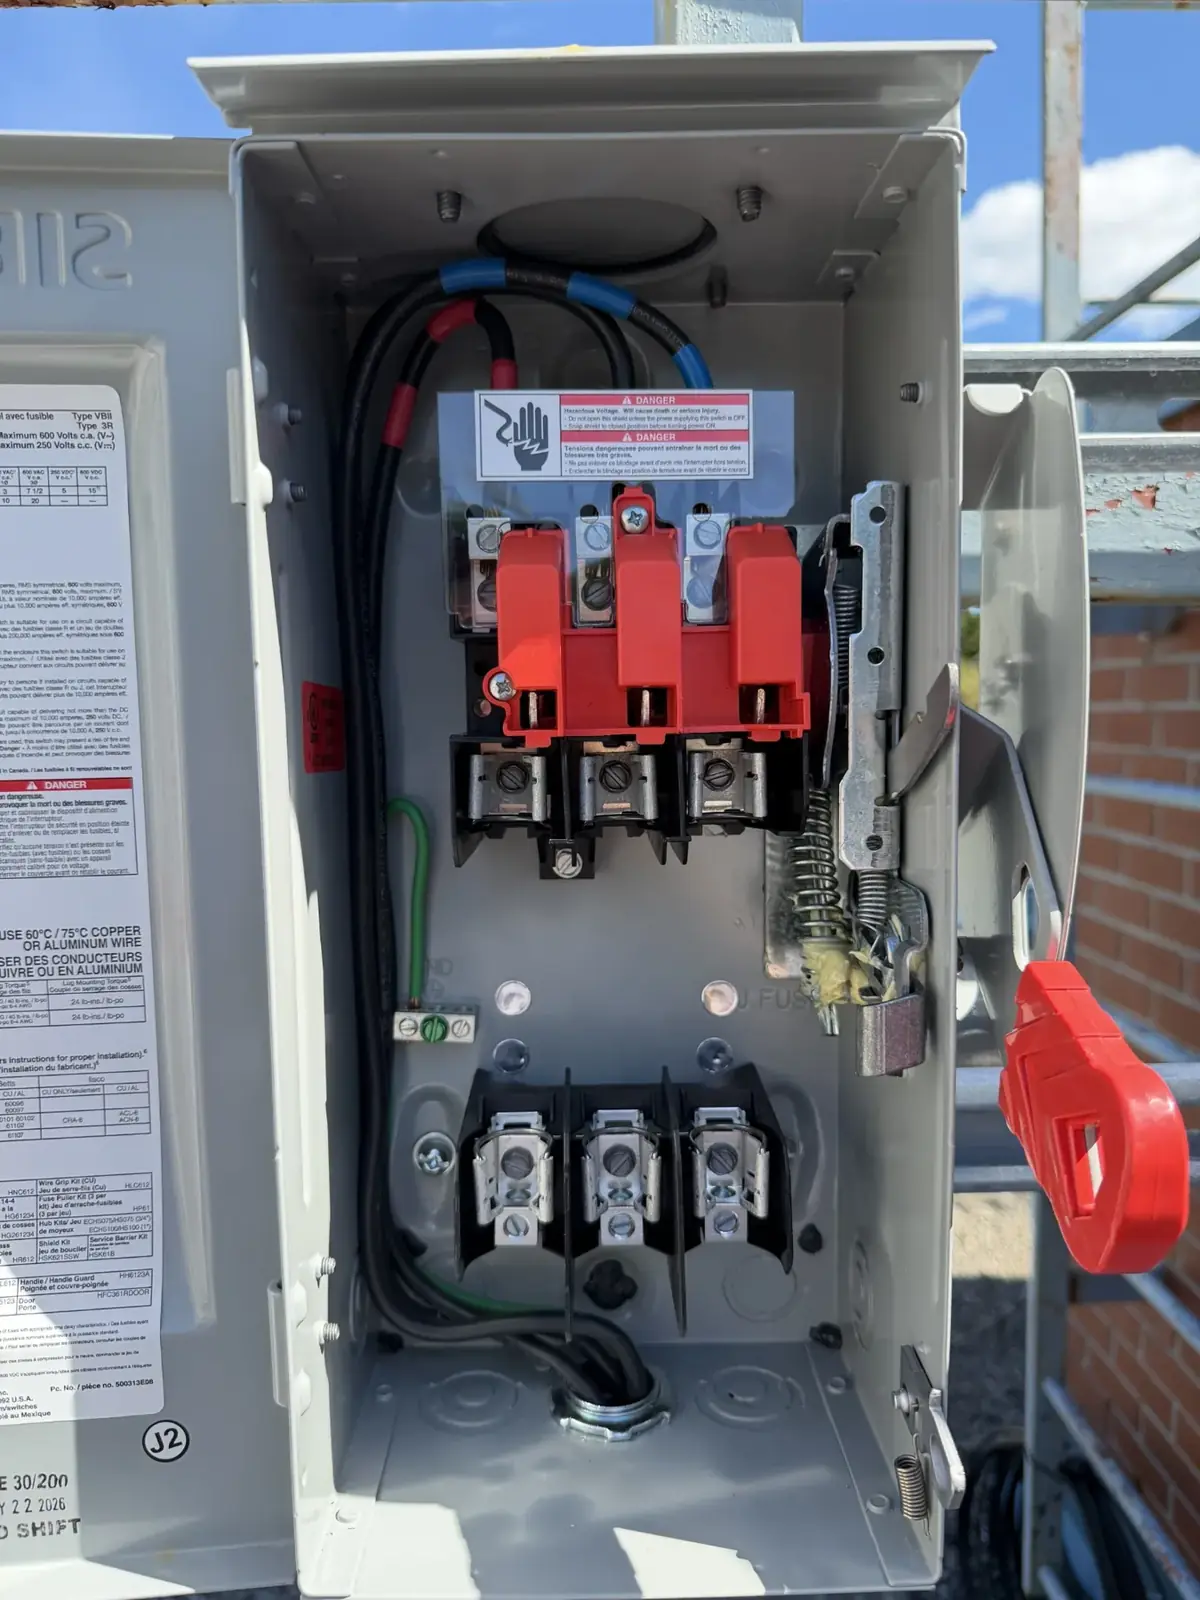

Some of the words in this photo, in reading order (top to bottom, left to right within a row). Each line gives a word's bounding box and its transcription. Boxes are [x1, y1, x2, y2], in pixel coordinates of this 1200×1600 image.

[635, 396, 676, 405] DANGER
[5, 413, 25, 421] avec
[26, 412, 55, 421] fusible
[71, 412, 93, 422] Type
[76, 421, 98, 431] Type
[101, 421, 114, 430] 3R
[39, 431, 55, 440] 600
[56, 431, 78, 440] Volts
[80, 432, 95, 440] c.a.
[635, 433, 676, 442] DANGER
[36, 441, 52, 449] 250
[54, 441, 76, 449] Volts
[44, 780, 87, 790] DANGER
[0, 929, 23, 940] USE
[25, 928, 52, 940] 60°C
[54, 928, 59, 939] /
[62, 927, 89, 939] 75°C
[91, 925, 142, 938] COPPER
[23, 940, 41, 952] OR
[43, 938, 109, 951] ALUMINUM
[111, 936, 142, 949] WIRE
[25, 955, 49, 967] DES
[51, 951, 143, 965] CONDUCTEURS
[37, 966, 55, 977] OU
[58, 965, 74, 976] EN
[77, 963, 143, 975] ALUMINIUM
[62, 980, 75, 988] Lug
[76, 979, 105, 987] Mounting
[70, 998, 81, 1006] 24
[759, 987, 810, 1010] FUS
[69, 1054, 96, 1063] proper
[39, 1178, 54, 1186] Wire
[55, 1178, 70, 1186] Grip
[56, 1193, 76, 1201] Puller
[77, 1192, 87, 1200] Kit
[95, 1193, 107, 1201] per
[46, 1211, 58, 1219] par
[12, 1221, 35, 1229] cosses
[48, 1227, 74, 1236] moyeux
[89, 1235, 114, 1243] Service
[115, 1233, 137, 1241] Barrier
[38, 1239, 60, 1247] Shield
[60, 1245, 87, 1253] bouclier
[12, 1256, 35, 1264] HR612
[20, 1278, 44, 1286] Handle
[49, 1276, 73, 1284] Handle
[74, 1274, 96, 1282] Guard
[20, 1284, 48, 1293] Poignée
[56, 1280, 110, 1290] couvre-poignée
[50, 1385, 62, 1393] Pc.
[63, 1383, 76, 1392] No.
[81, 1381, 101, 1391] pièce
[102, 1381, 114, 1389] no.
[12, 1395, 34, 1404] U.S.A.
[21, 1410, 51, 1420] Mexique
[149, 1427, 183, 1455] J2
[38, 1496, 67, 1512] 2026
[16, 1517, 82, 1539] SHIFT
